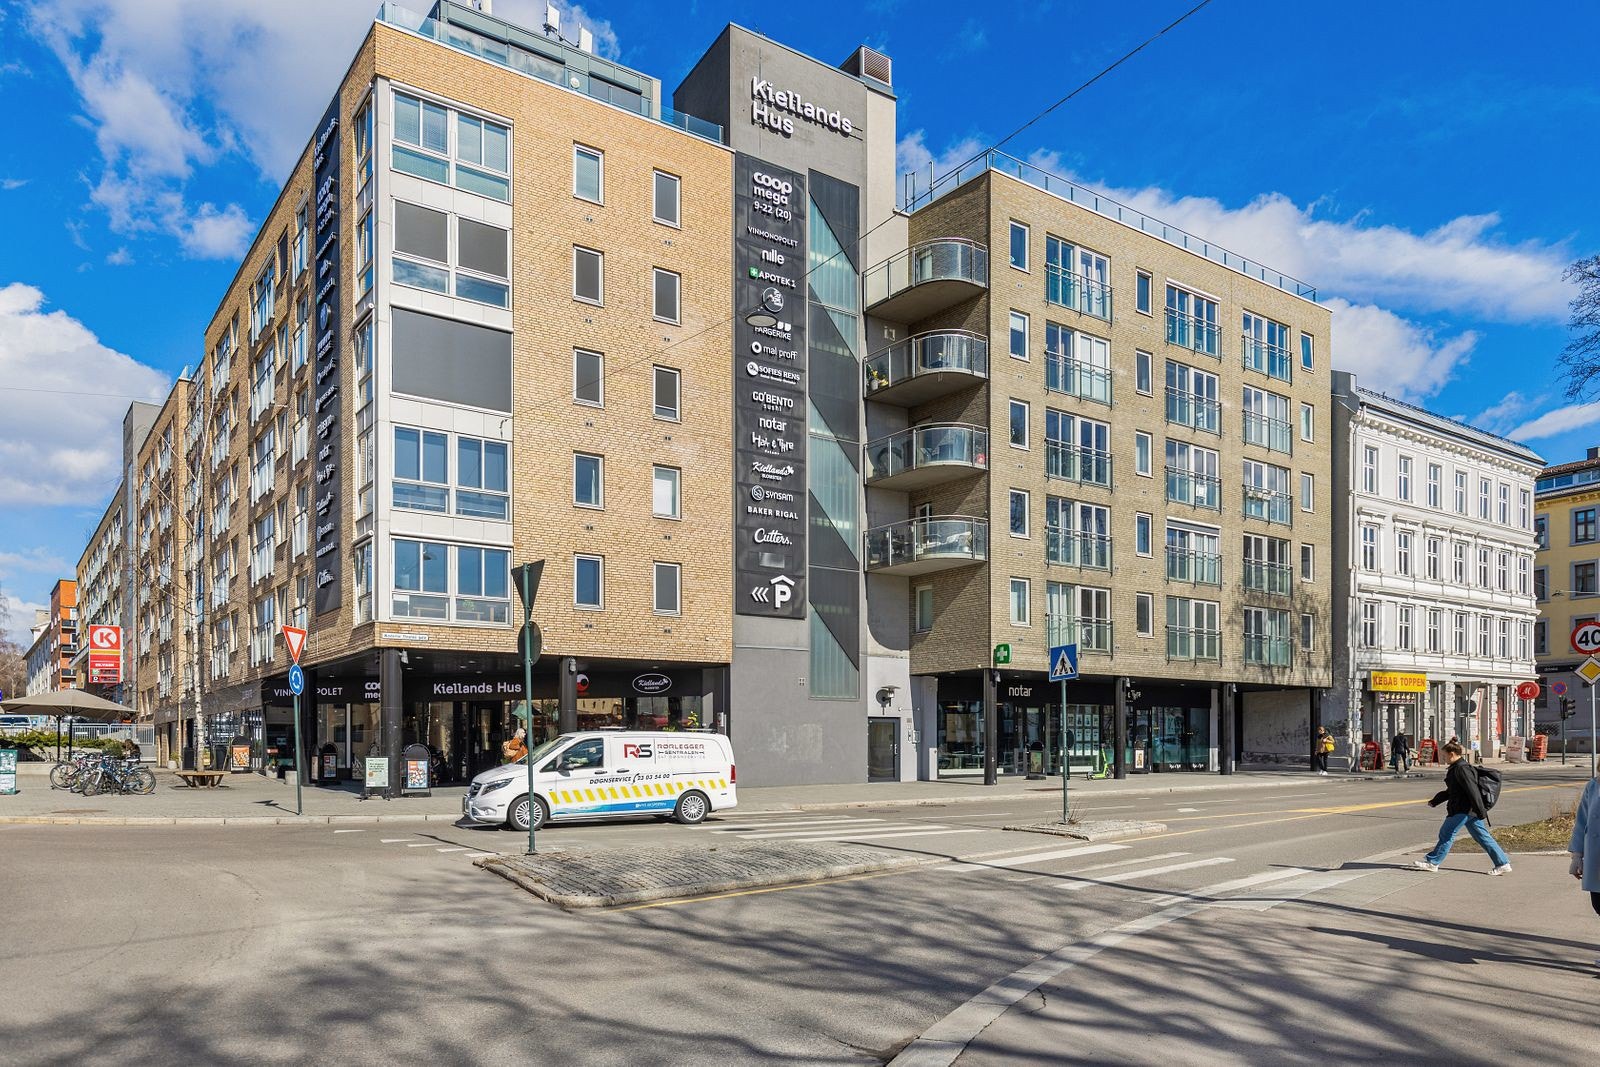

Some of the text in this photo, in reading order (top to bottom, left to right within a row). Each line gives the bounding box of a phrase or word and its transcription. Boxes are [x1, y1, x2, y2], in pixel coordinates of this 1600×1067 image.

[752, 76, 853, 134] Kiellands
[752, 101, 794, 135] Hus
[754, 172, 792, 195] coop
[754, 184, 788, 205] mega
[754, 201, 792, 222] 9-22 (20)
[747, 226, 798, 247] VINMONOPOLET
[761, 249, 784, 265] nille
[758, 271, 790, 287] APOTEK
[763, 345, 798, 360] mal proff
[783, 371, 800, 381] RENS
[759, 417, 787, 431] notar
[753, 461, 790, 476] Kiellands
[747, 506, 798, 520] BAKER RIGAL
[775, 584, 791, 608] P
[433, 682, 522, 695] Kiellands Hus
[1372, 674, 1426, 688] KEBAB TOPPEN
[1008, 684, 1033, 697] notar
[623, 744, 653, 758] RS
[589, 776, 632, 784] DØGNSERVICE
